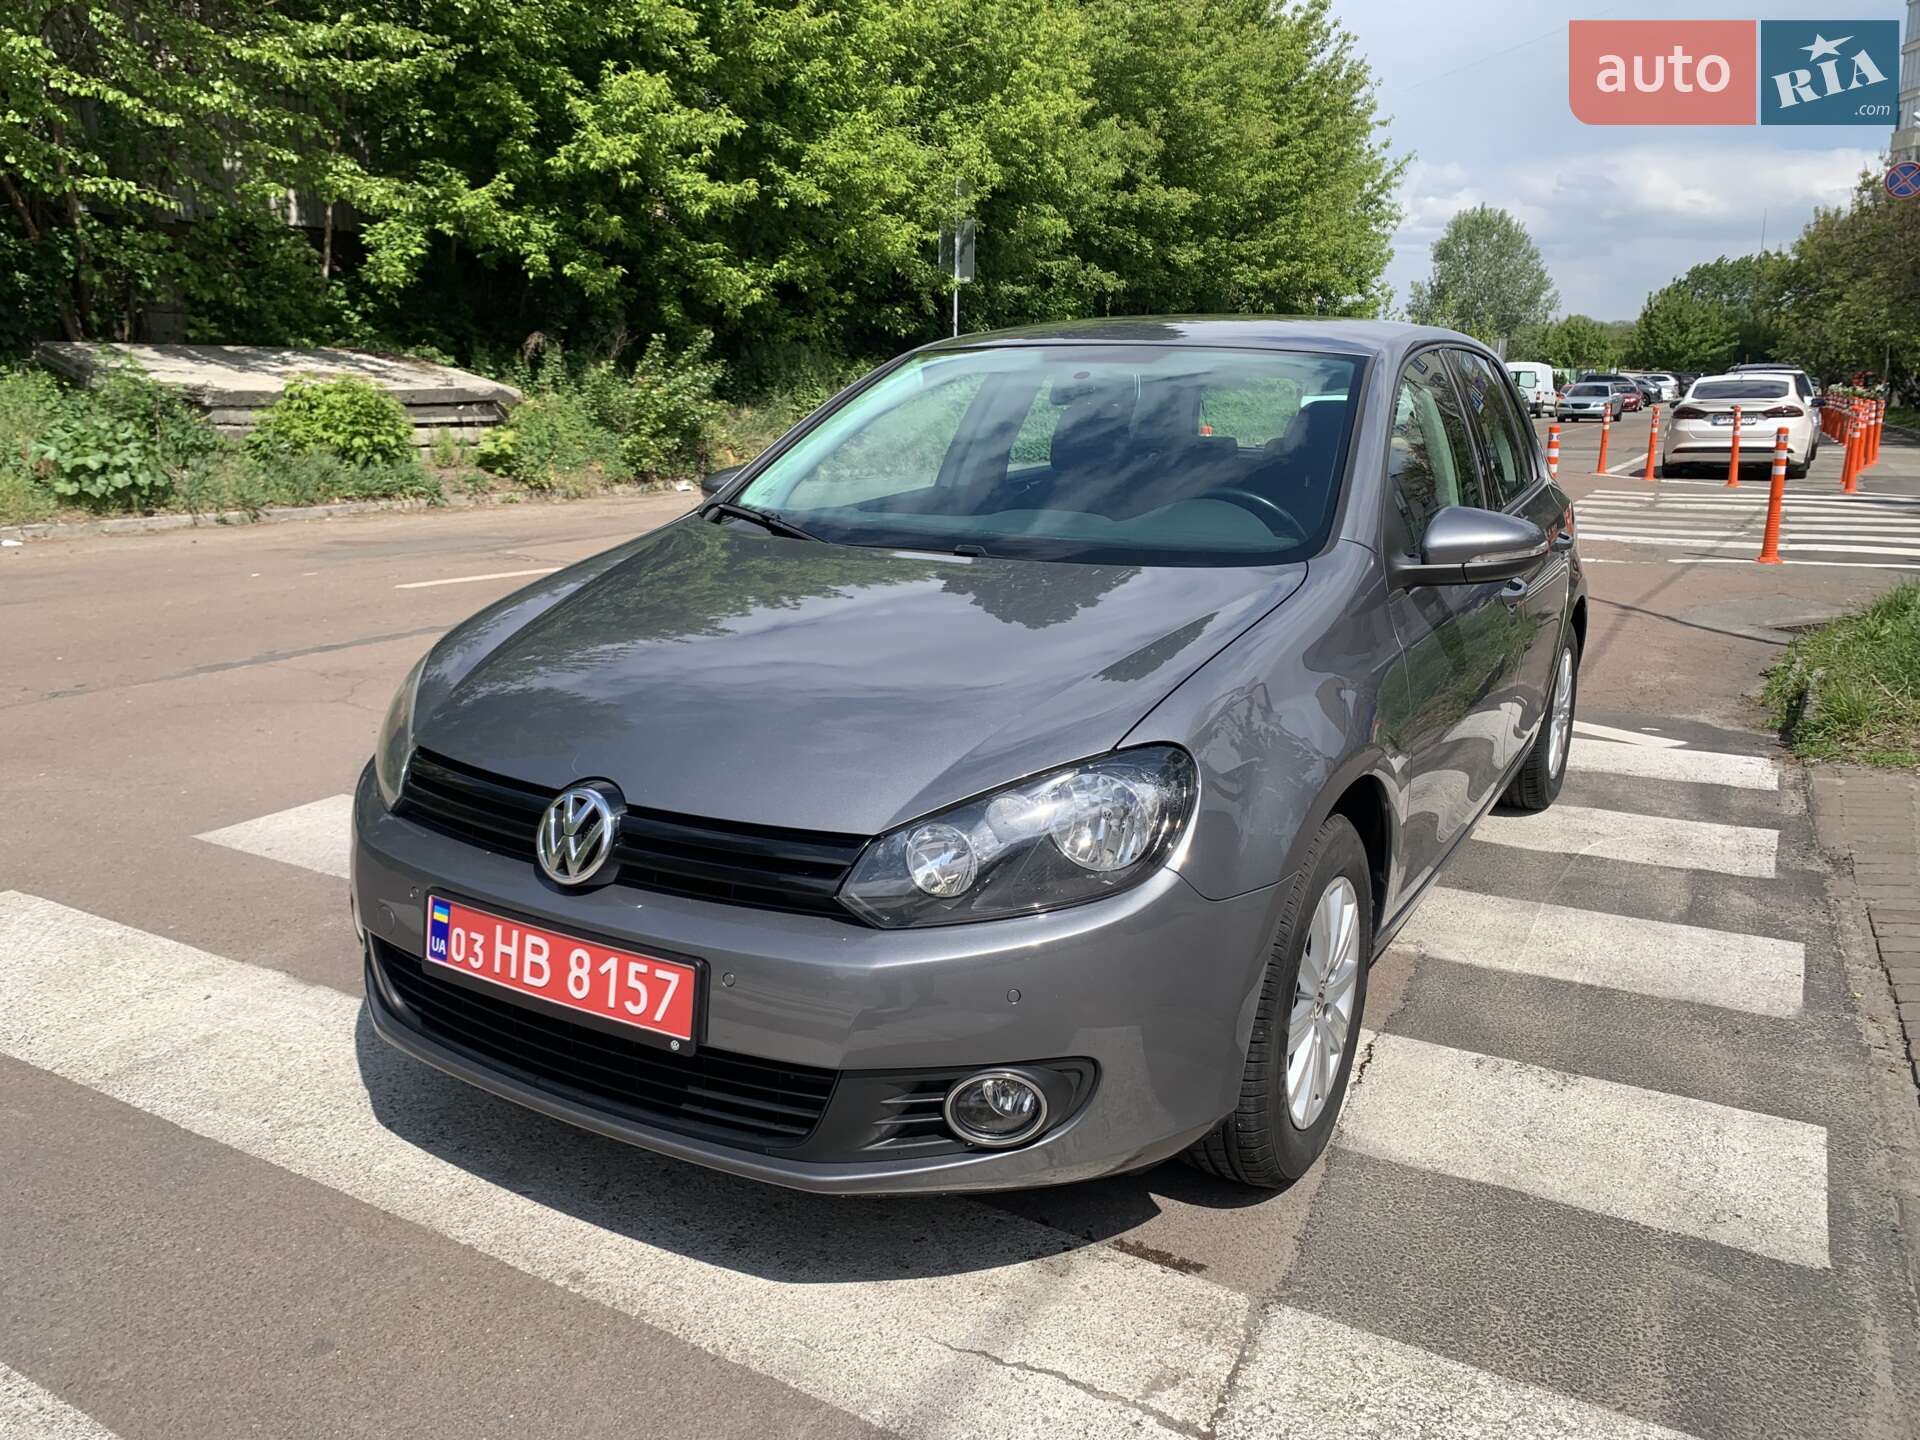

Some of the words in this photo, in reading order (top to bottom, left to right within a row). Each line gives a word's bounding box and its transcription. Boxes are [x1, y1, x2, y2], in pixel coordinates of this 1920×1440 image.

[431, 935, 447, 956] UA
[451, 927, 485, 969] 03
[493, 924, 551, 988] HB
[567, 948, 680, 1022] 8157
